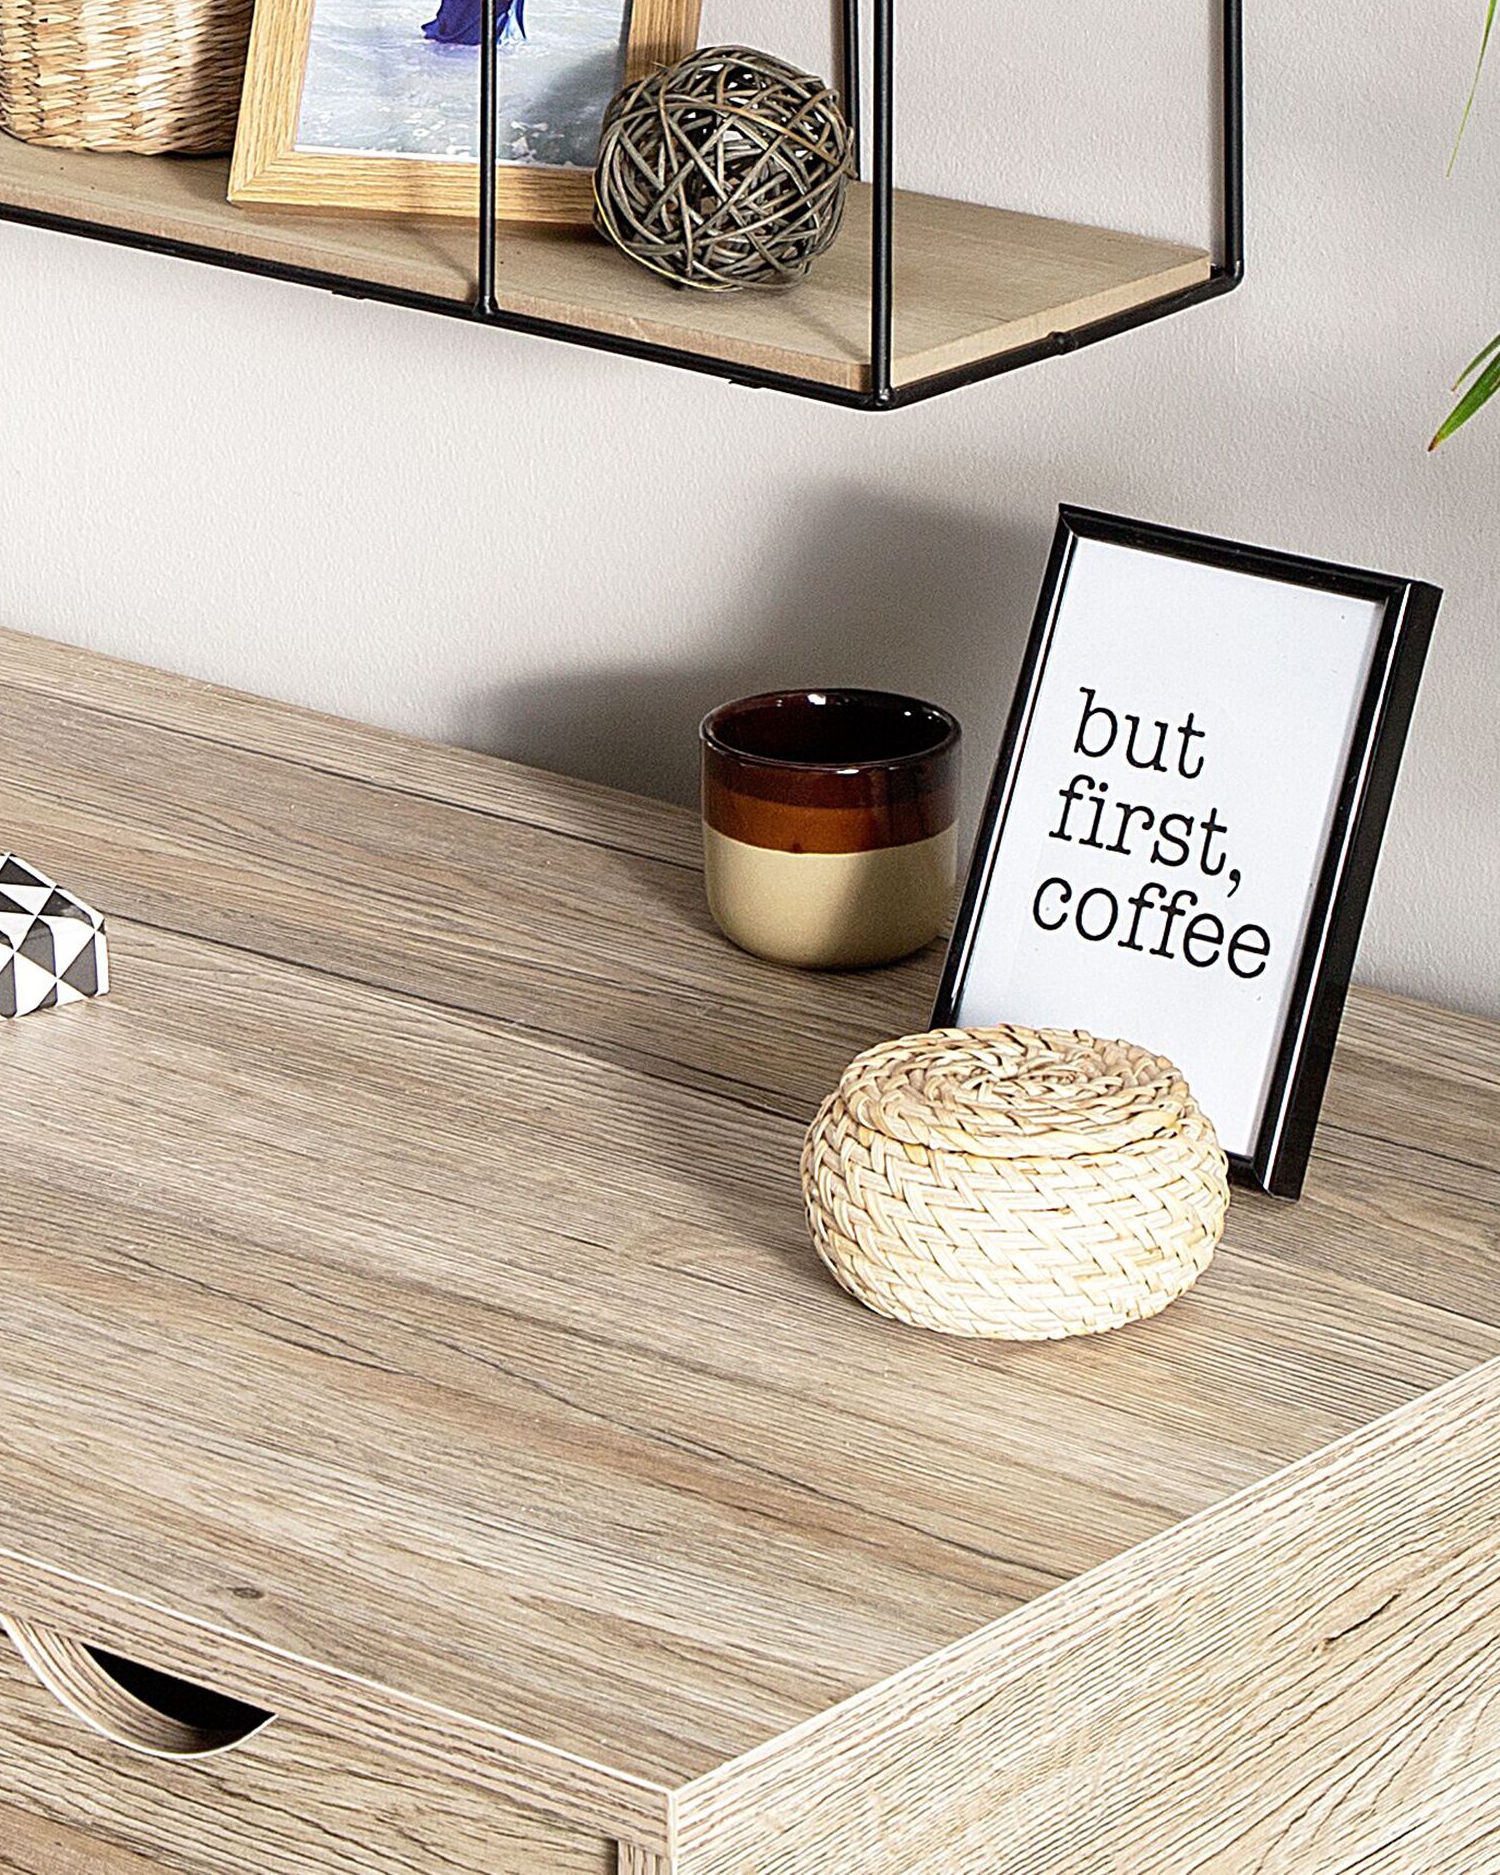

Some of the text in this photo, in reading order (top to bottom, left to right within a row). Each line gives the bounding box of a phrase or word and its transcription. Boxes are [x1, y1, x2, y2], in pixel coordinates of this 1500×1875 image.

[1073, 686, 1206, 780] but
[1048, 774, 1242, 898] first,
[1032, 877, 1271, 979] coffee
